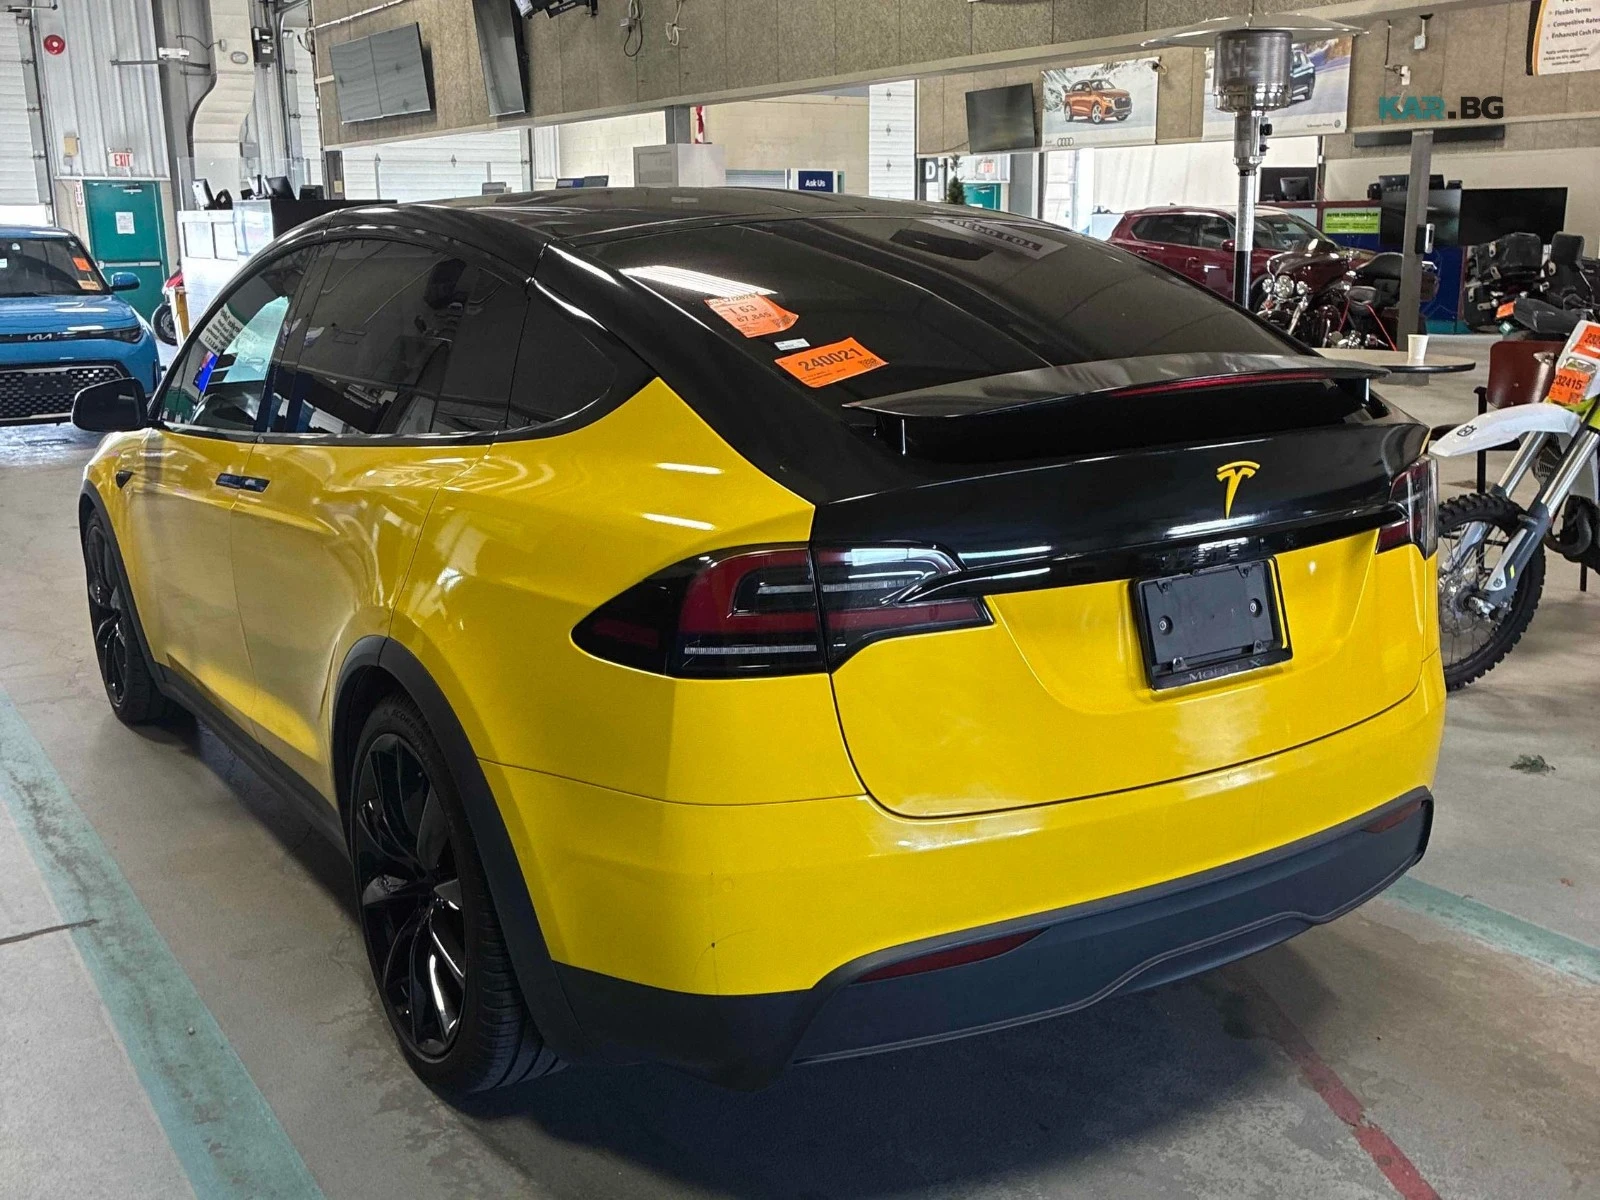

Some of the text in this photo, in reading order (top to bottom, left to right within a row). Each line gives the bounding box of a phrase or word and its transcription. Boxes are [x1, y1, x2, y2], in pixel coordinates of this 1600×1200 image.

[114, 154, 130, 166] EXIT
[926, 161, 936, 179] D
[805, 179, 826, 187] Ask Us
[798, 347, 864, 372] 240021
